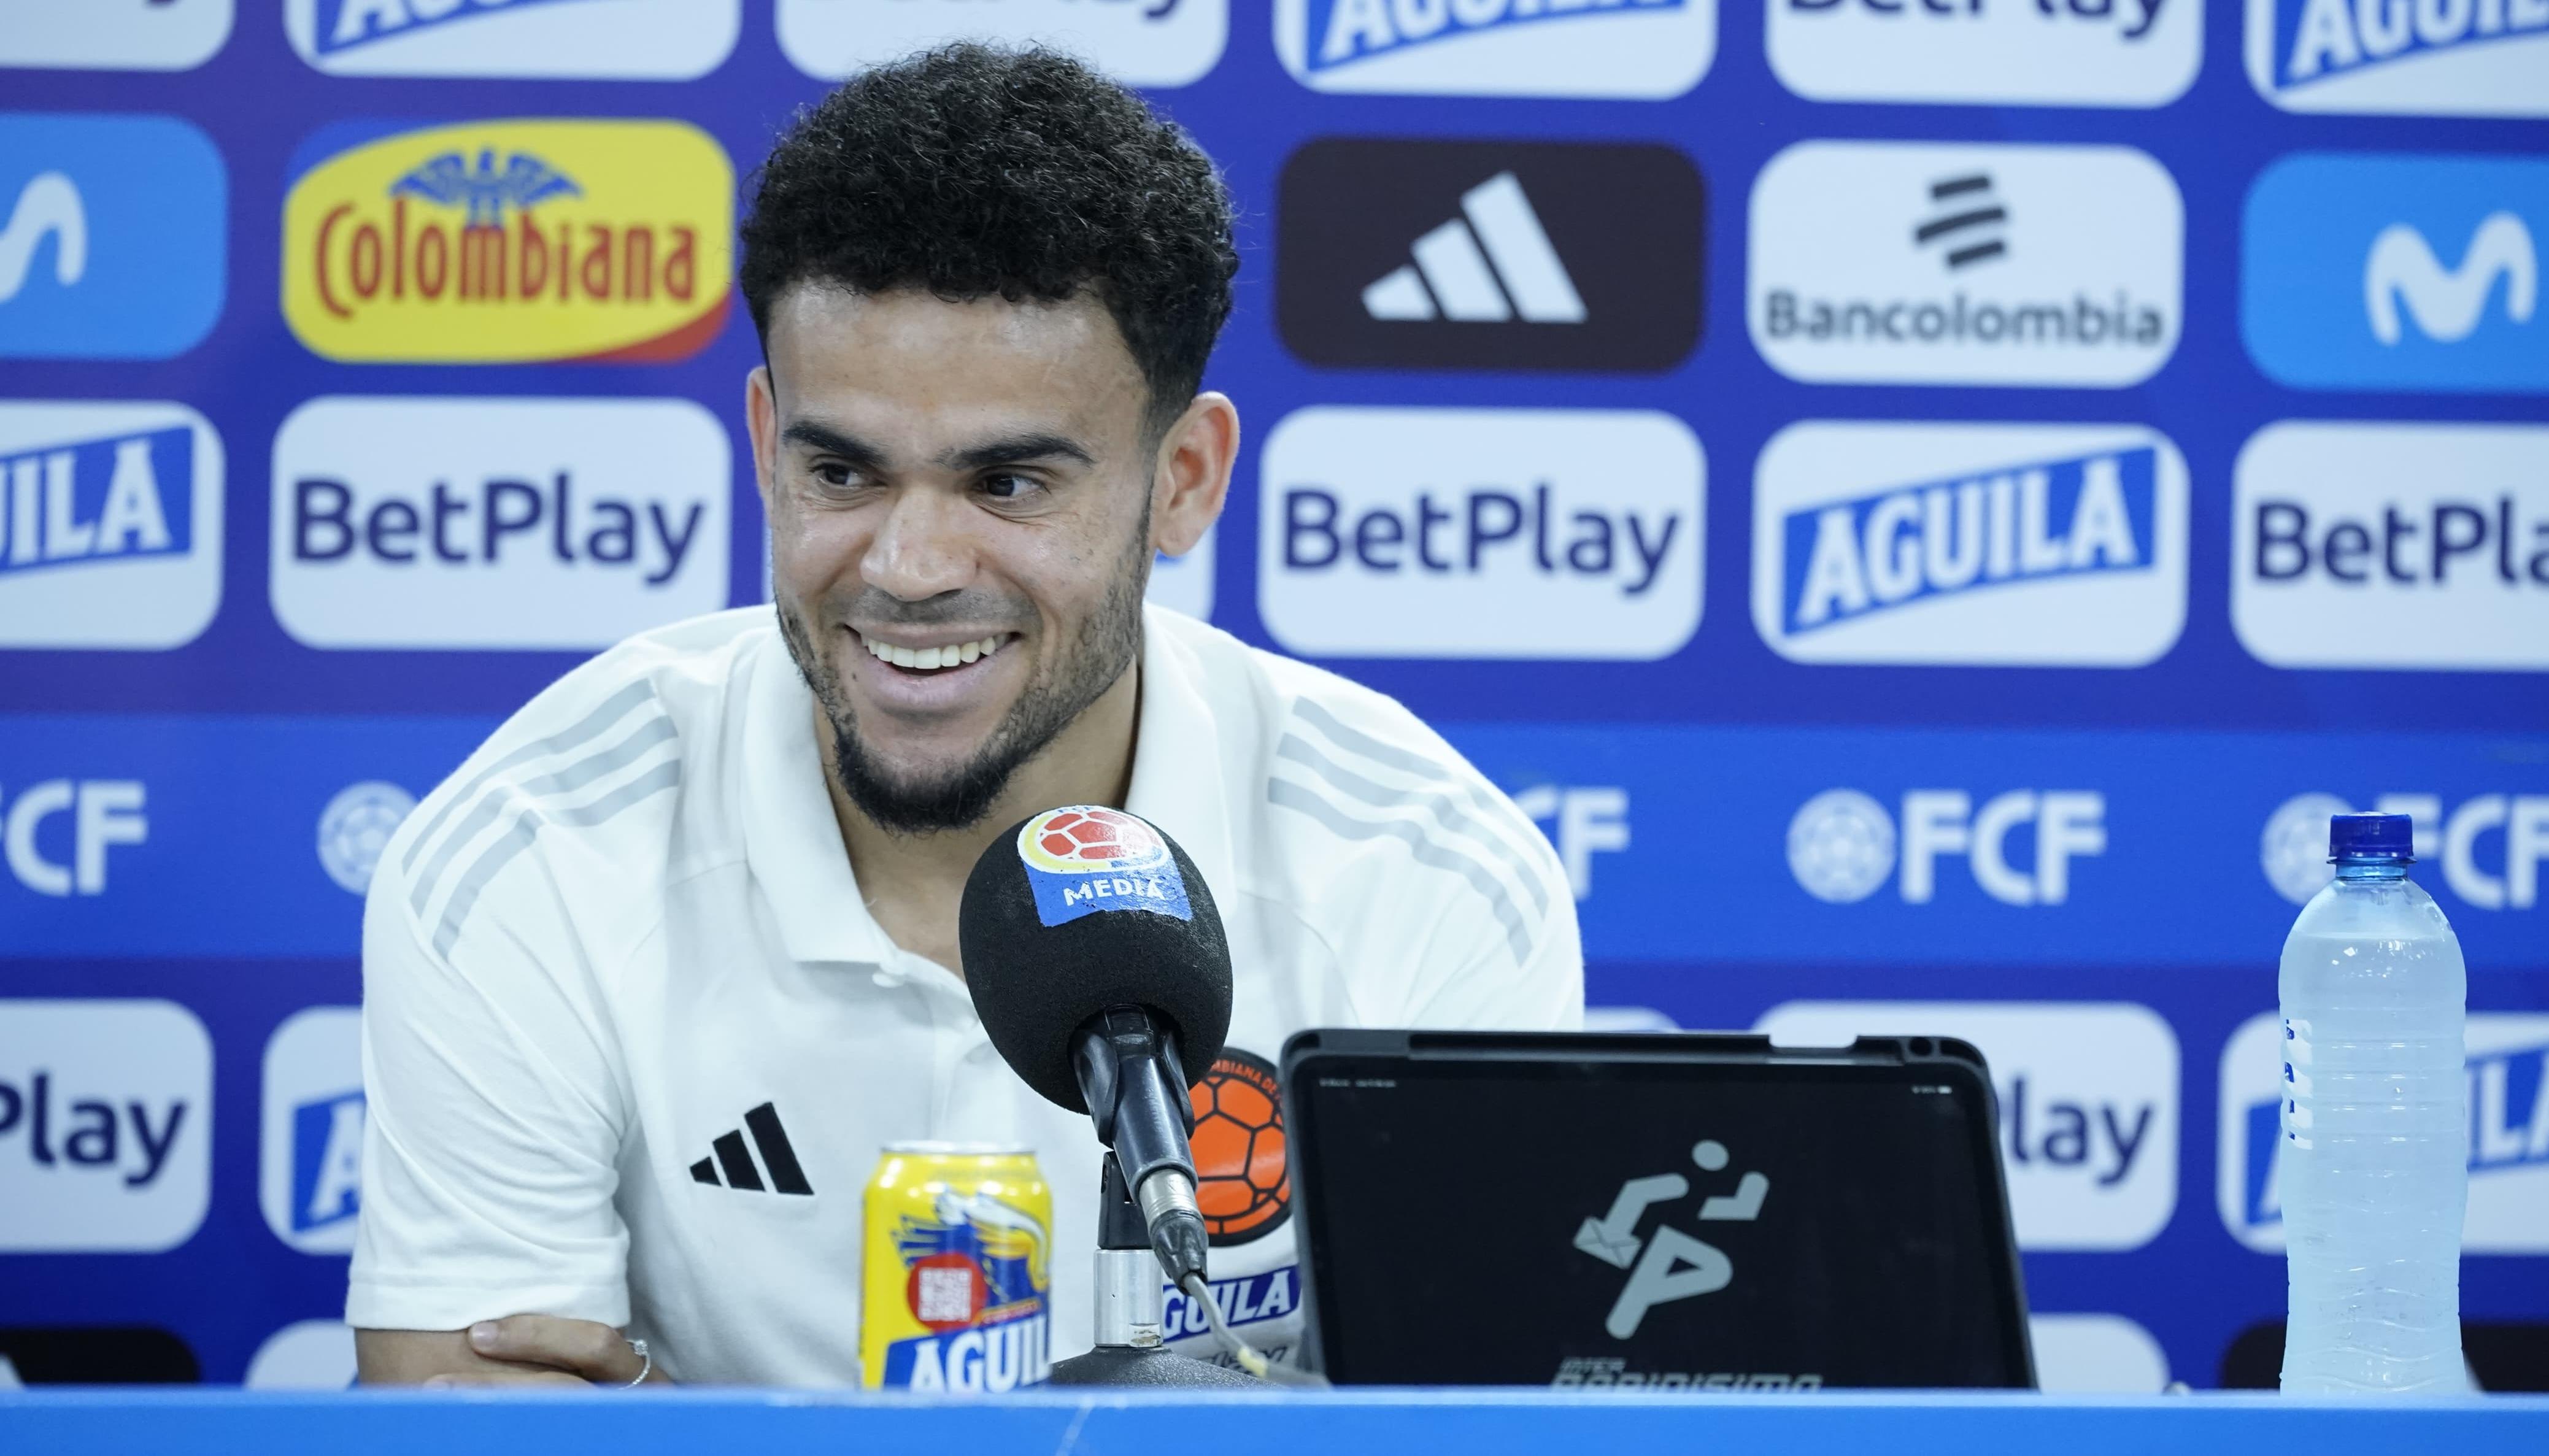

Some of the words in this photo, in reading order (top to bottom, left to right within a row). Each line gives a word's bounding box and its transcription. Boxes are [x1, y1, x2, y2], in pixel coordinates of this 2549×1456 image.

[315, 195, 695, 319] Colombiana
[1765, 291, 2164, 346] Bancolombia
[0, 440, 172, 567] ILA
[292, 471, 704, 586] BetPlay
[1284, 483, 1679, 595] BetPlay
[1795, 457, 2138, 627] AGUILA
[0, 779, 148, 896] CF
[1063, 878, 1165, 907] MEDIA
[1901, 788, 2107, 906] FCF
